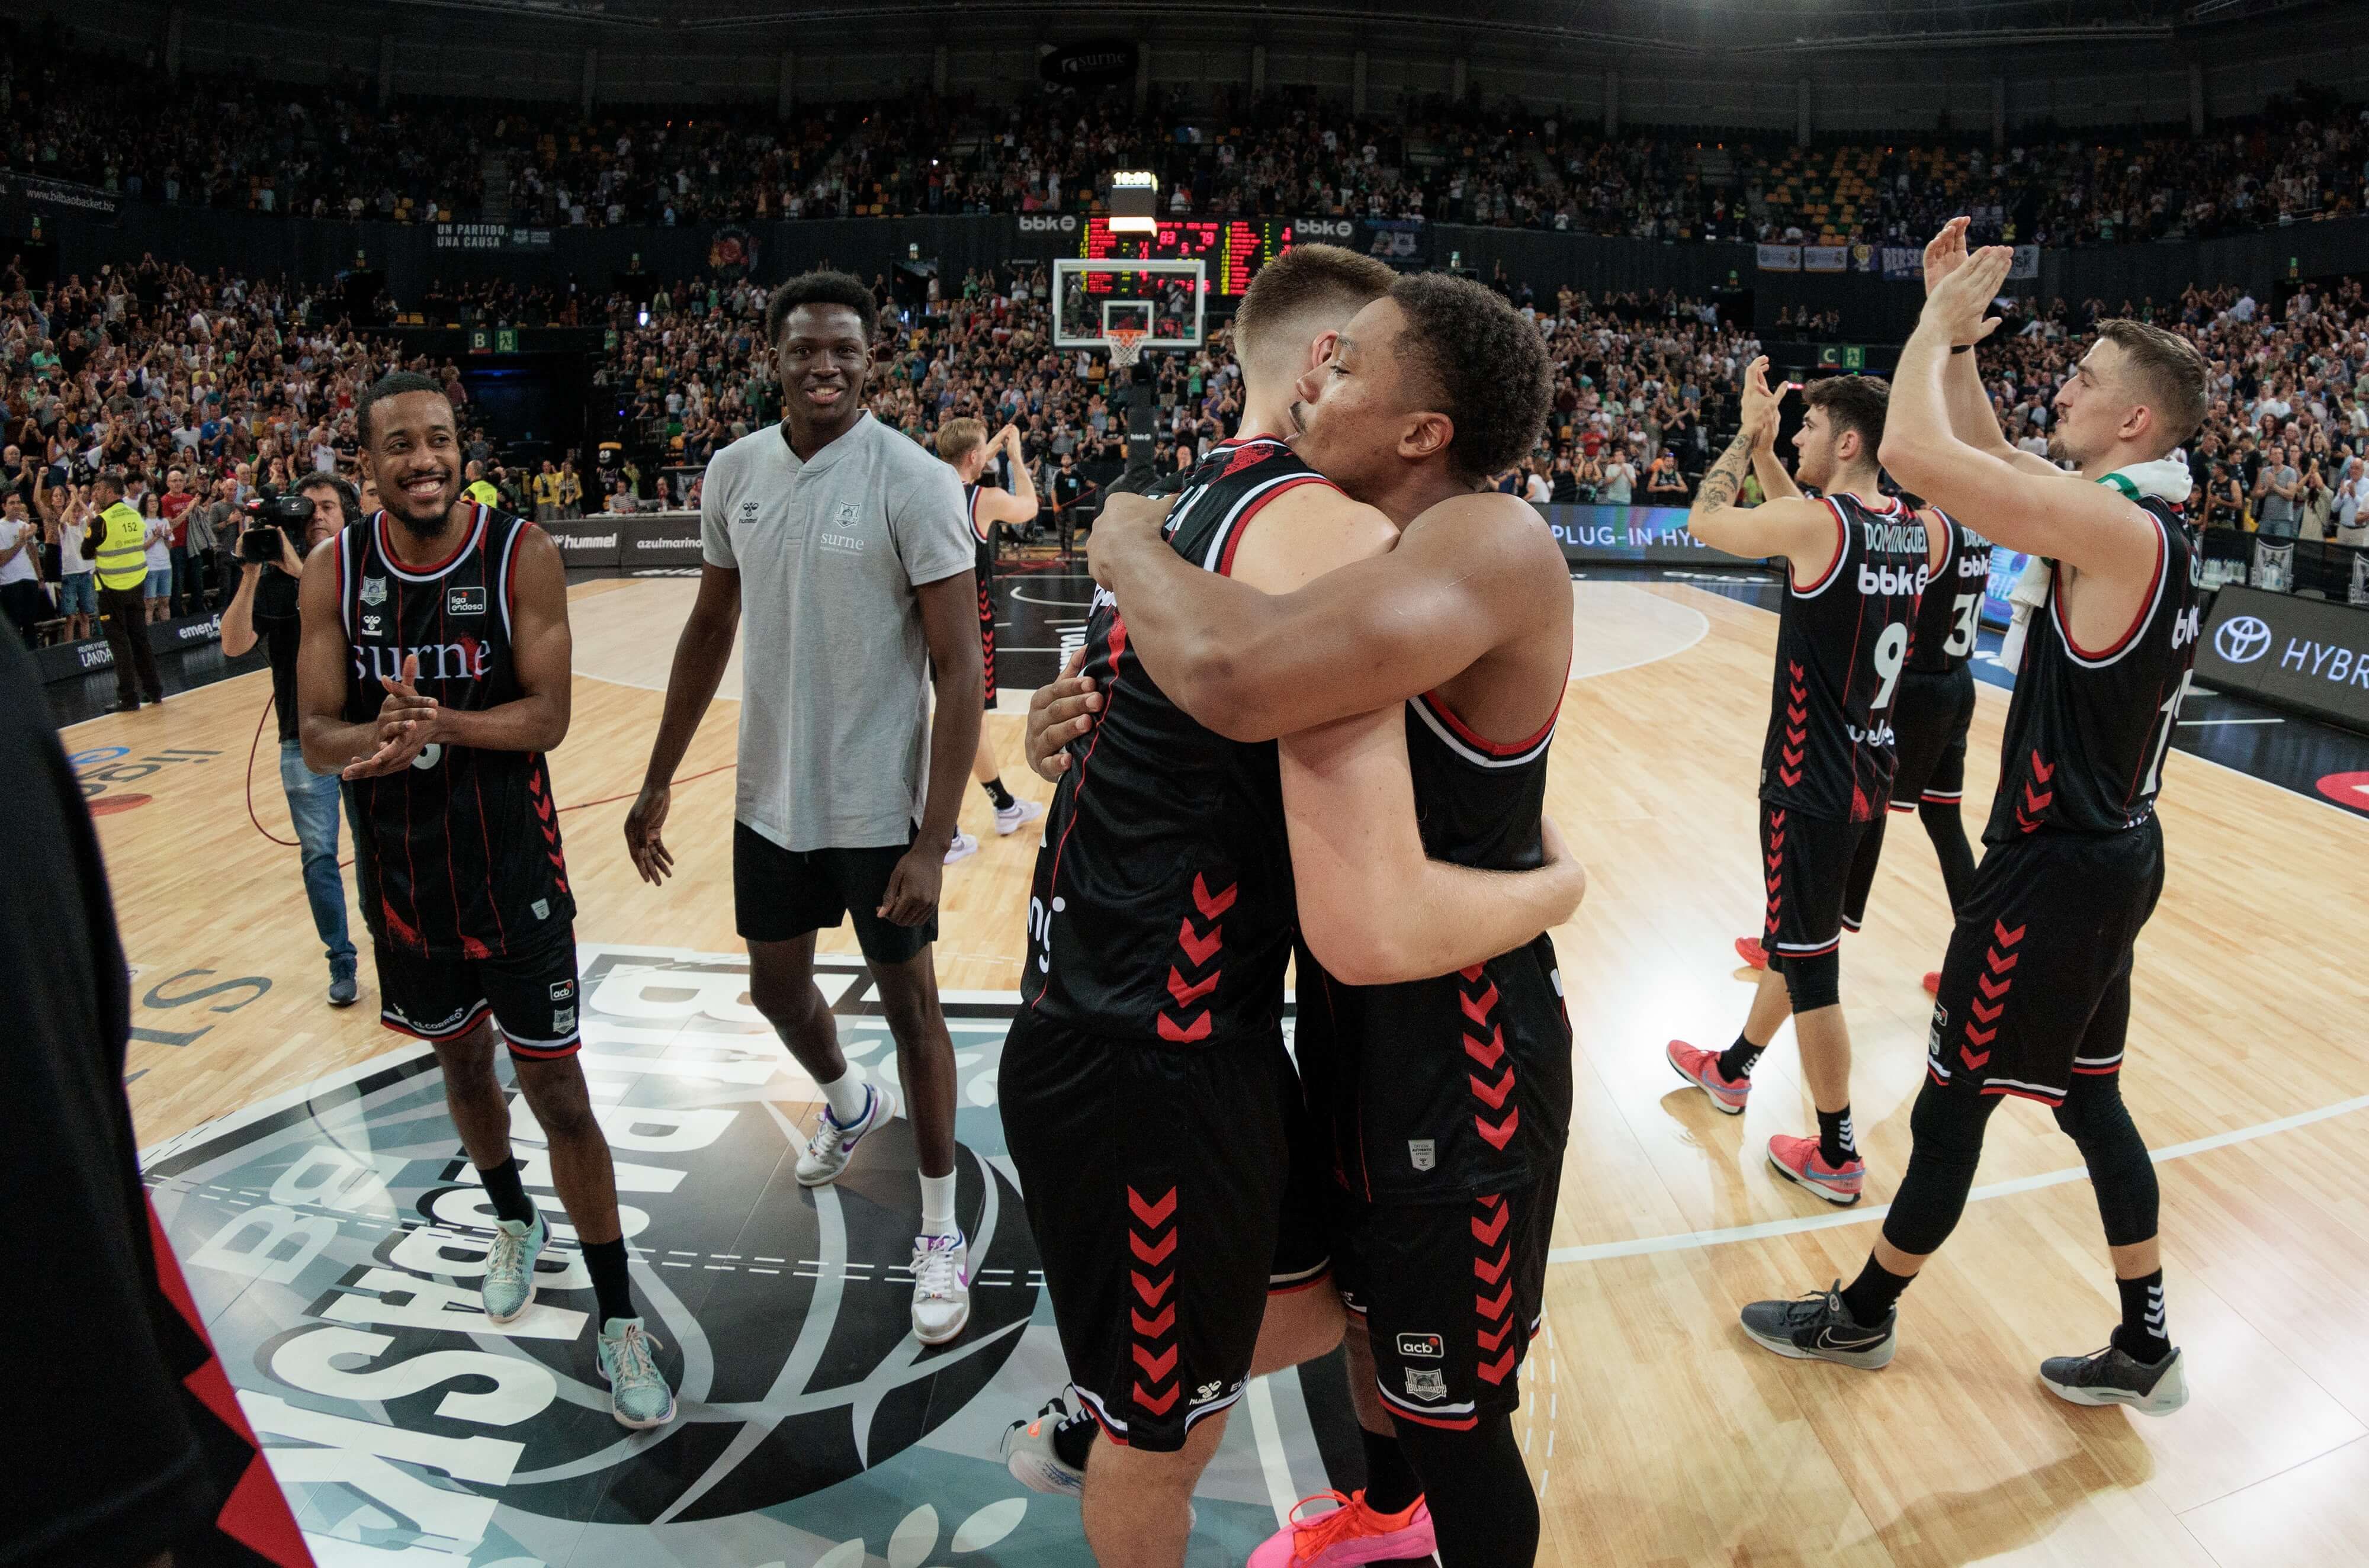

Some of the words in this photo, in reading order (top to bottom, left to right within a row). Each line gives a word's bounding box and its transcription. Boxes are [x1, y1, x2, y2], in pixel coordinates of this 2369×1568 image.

[437, 224, 452, 234] UN
[1019, 216, 1058, 230] bbk
[1295, 219, 1335, 234] bbk
[437, 236, 459, 248] UNA
[464, 237, 500, 248] CAUSA
[474, 333, 485, 348] B
[1824, 348, 1835, 362] C
[122, 522, 137, 533] 152
[564, 533, 617, 550] hummel
[820, 533, 864, 550] surne
[1858, 563, 1914, 596] bbk
[451, 596, 466, 604] liga
[451, 603, 483, 612] endesa
[353, 640, 491, 682] surne
[1870, 622, 1908, 709] 9
[553, 987, 569, 998] acb
[1403, 1342, 1433, 1354] acb
